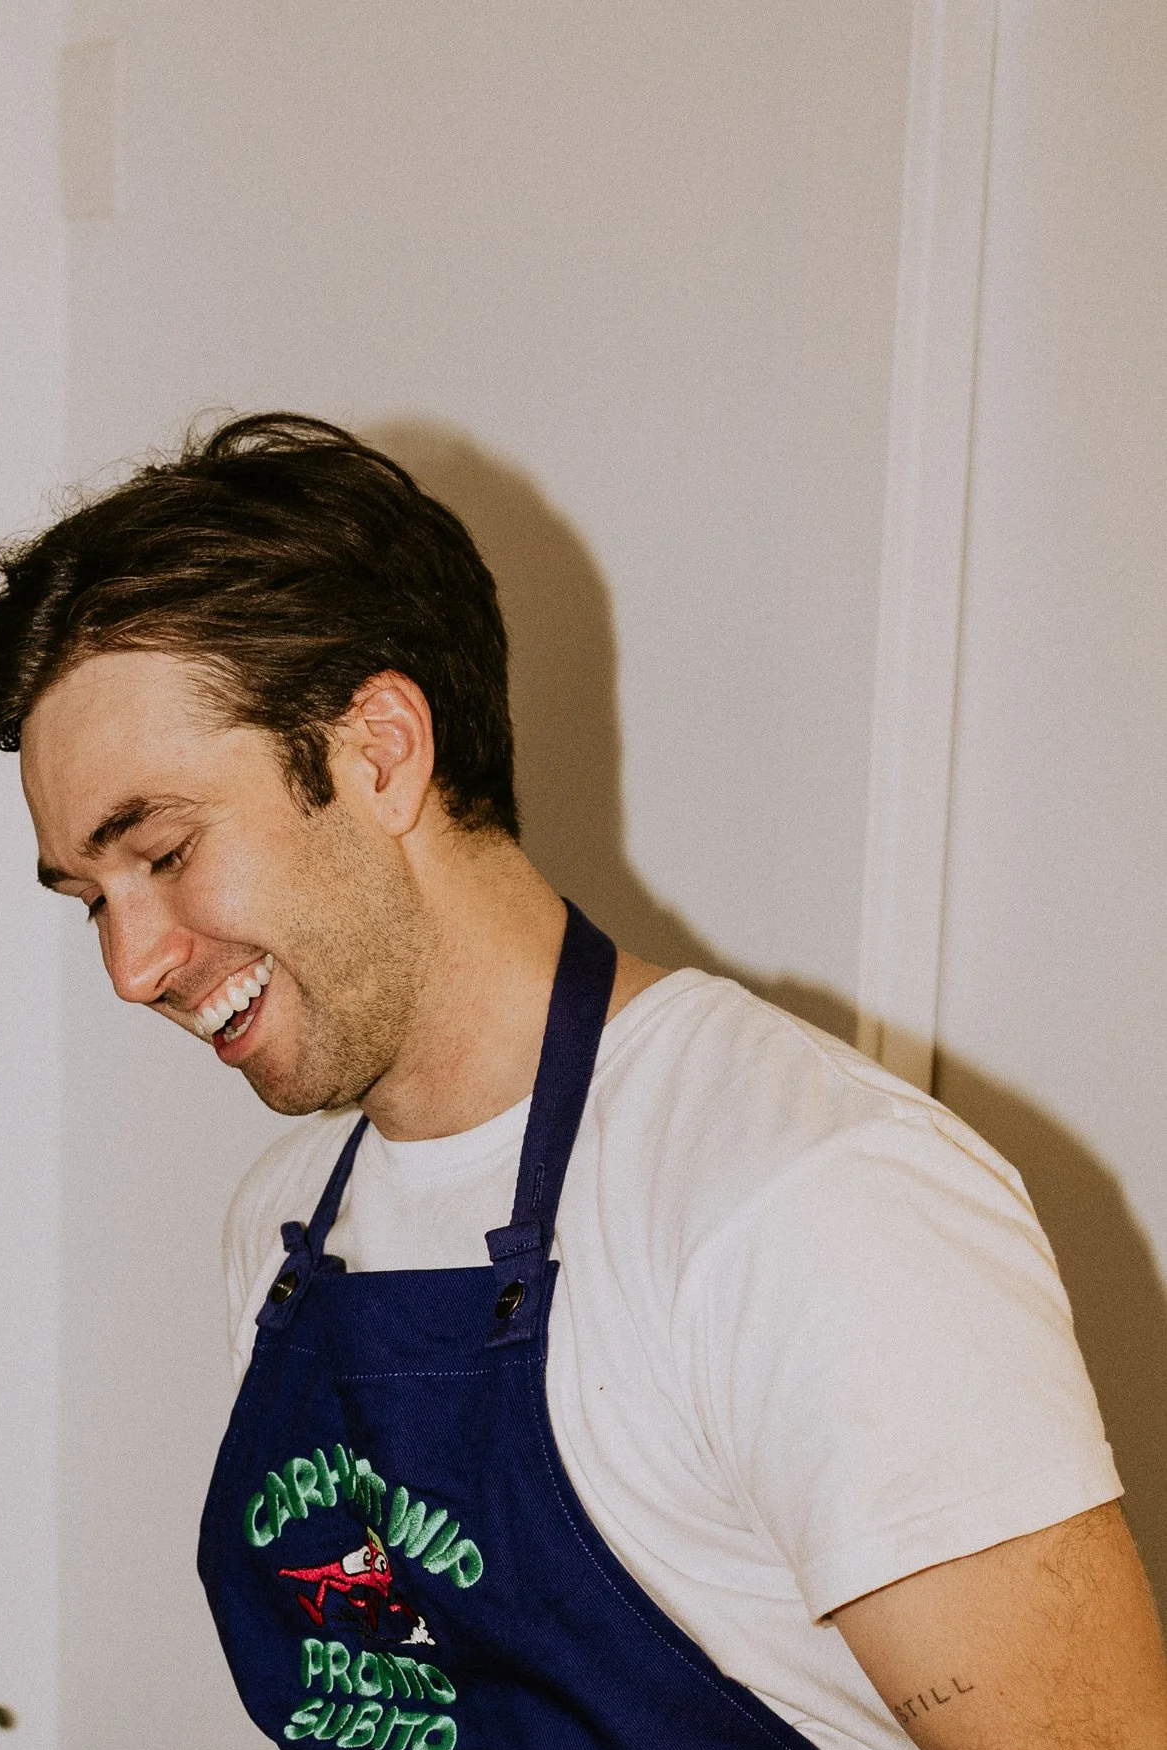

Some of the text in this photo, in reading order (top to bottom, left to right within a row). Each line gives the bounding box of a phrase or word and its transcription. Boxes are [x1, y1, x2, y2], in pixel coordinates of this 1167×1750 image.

[243, 1443, 484, 1588] CARHTT WIP
[300, 1638, 457, 1705] PRONTO
[894, 1677, 975, 1723] STILL
